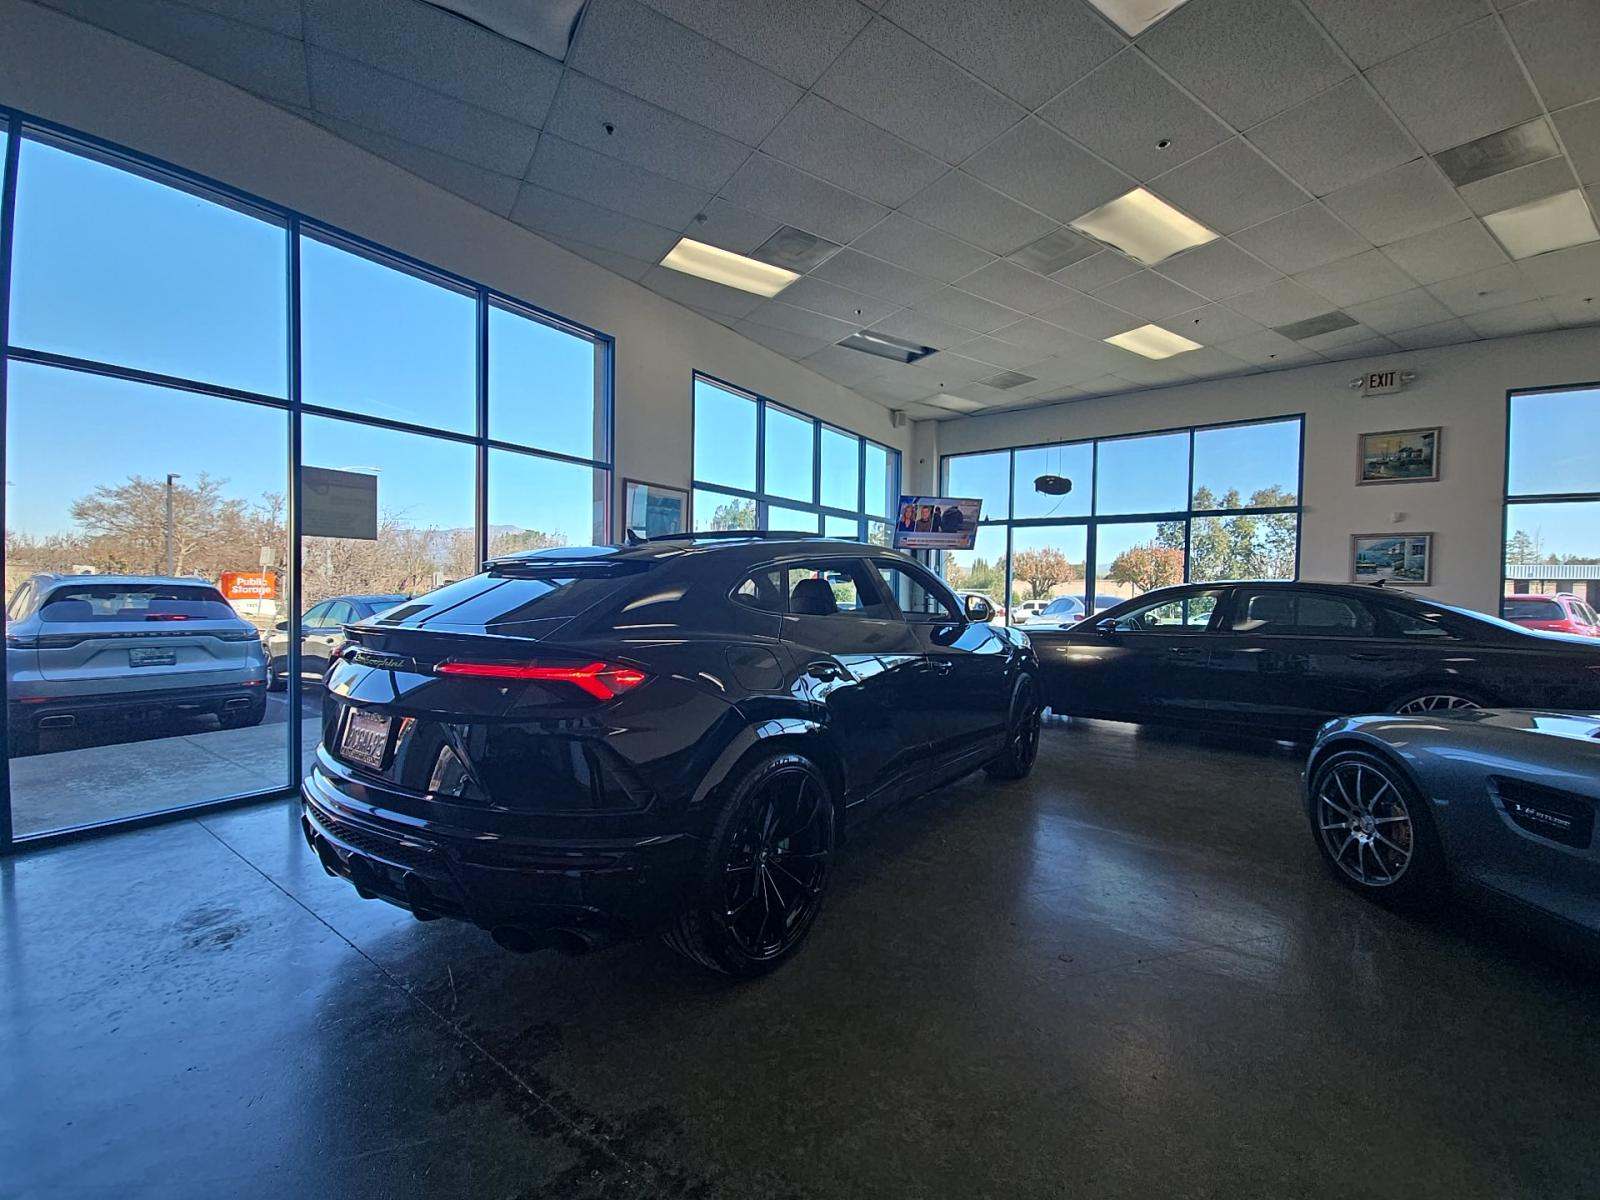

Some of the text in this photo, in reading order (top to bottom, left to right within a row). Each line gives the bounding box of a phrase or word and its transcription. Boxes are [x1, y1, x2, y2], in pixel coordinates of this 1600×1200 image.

[1369, 371, 1396, 389] EXIT
[236, 577, 268, 586] Public
[231, 585, 272, 596] Storage
